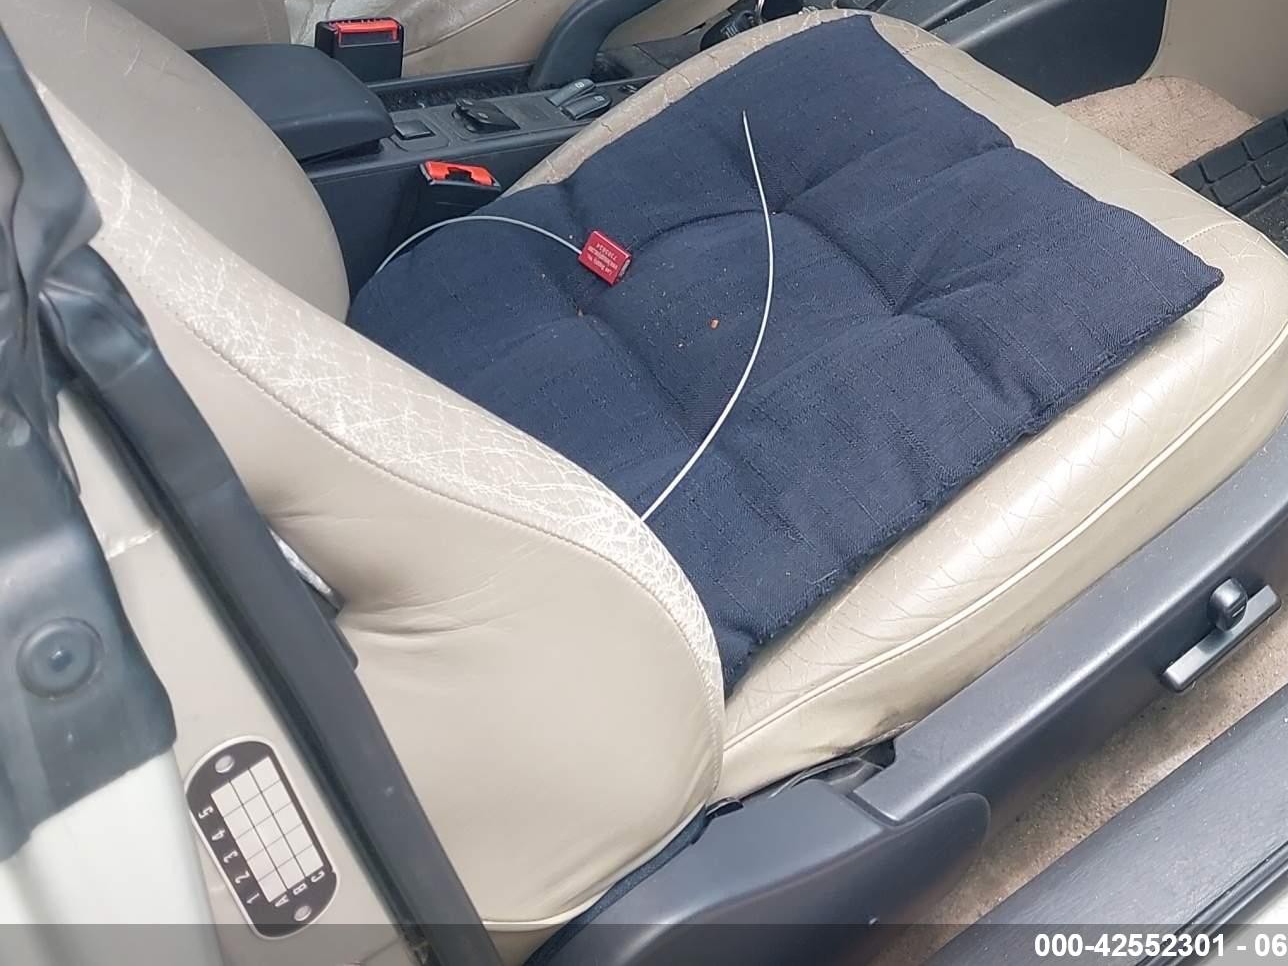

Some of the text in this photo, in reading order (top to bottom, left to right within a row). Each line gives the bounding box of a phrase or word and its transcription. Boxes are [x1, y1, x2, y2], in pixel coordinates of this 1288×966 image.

[198, 805, 215, 819] 5
[223, 850, 239, 864] 3
[234, 870, 250, 885] 2
[246, 891, 260, 904] 1
[274, 894, 290, 908] A
[292, 883, 308, 896] B
